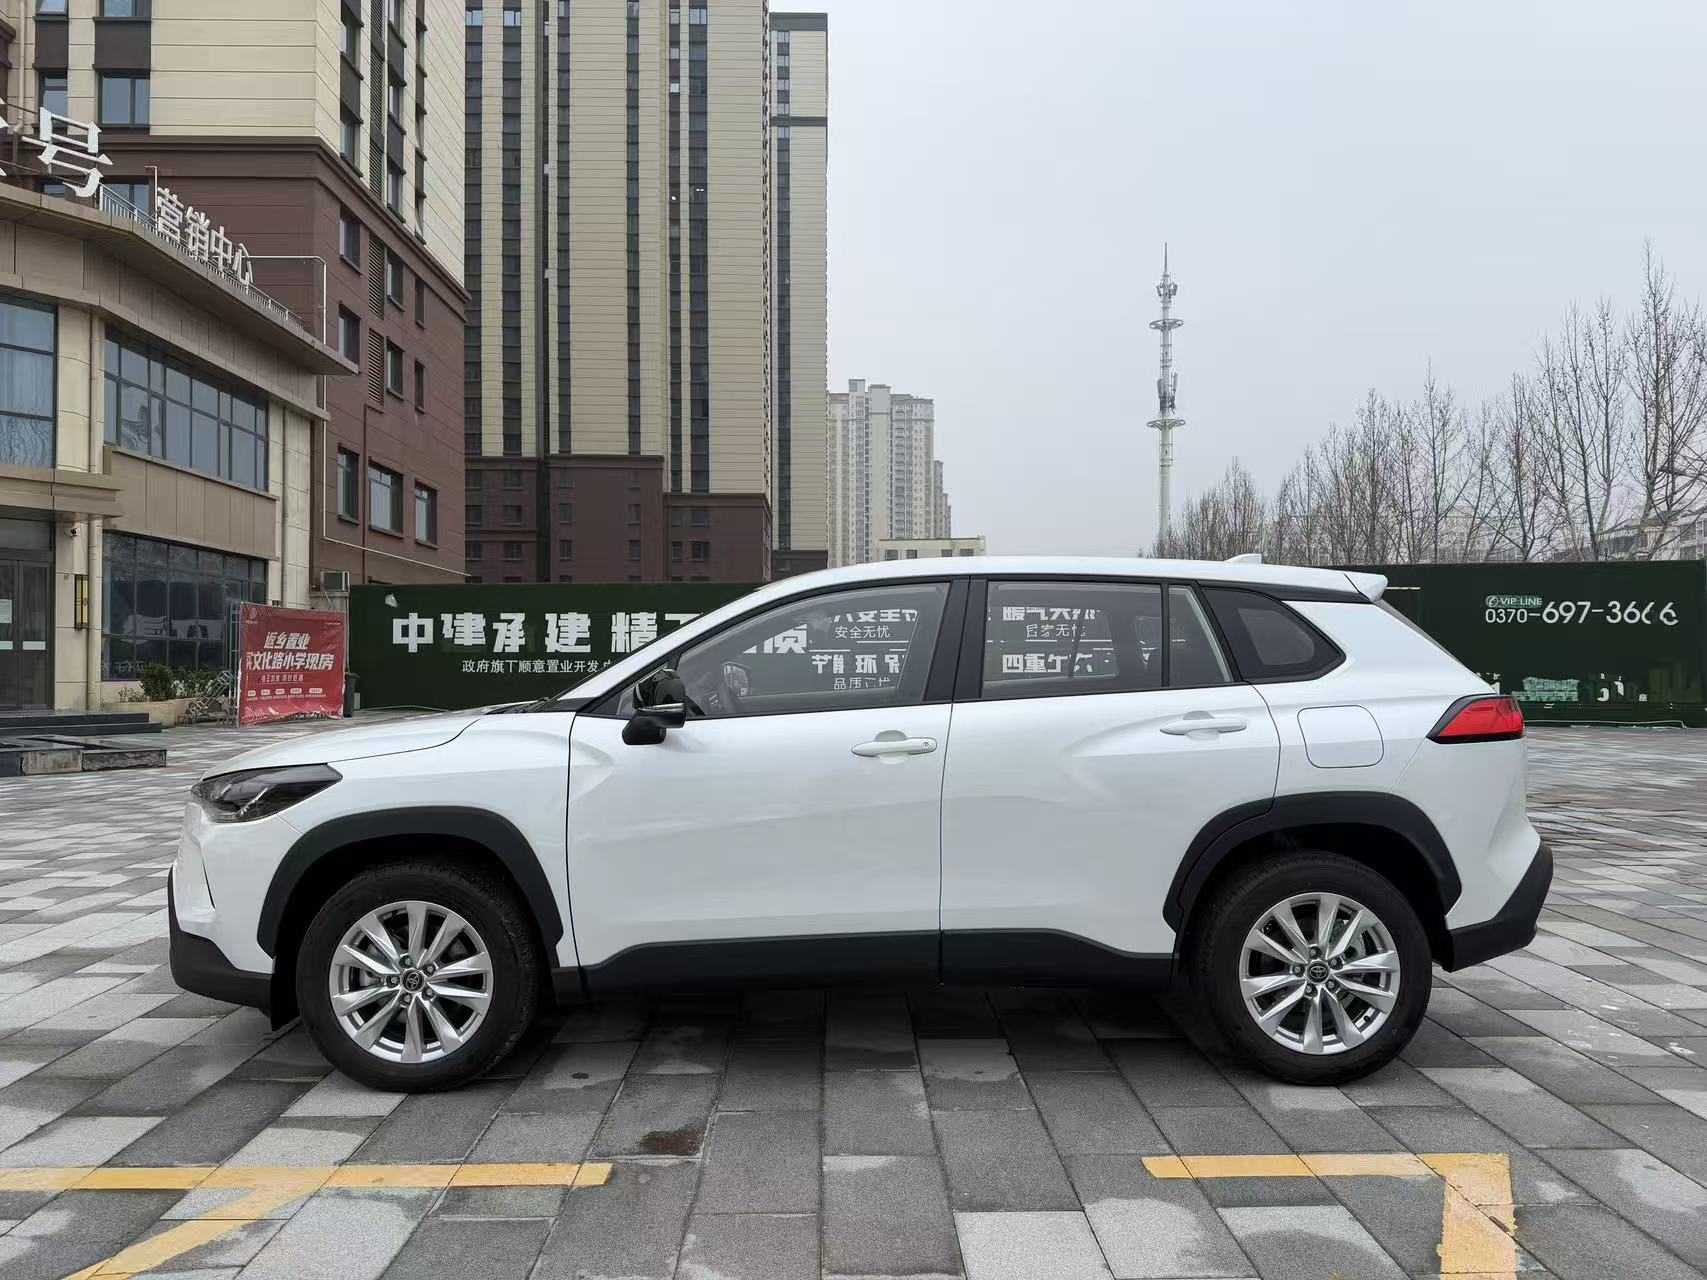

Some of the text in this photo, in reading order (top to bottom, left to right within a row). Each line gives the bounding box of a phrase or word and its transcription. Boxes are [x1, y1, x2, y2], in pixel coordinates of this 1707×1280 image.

[156, 186, 254, 287] 营销中心
[1500, 597, 1543, 606] VIP LINE
[264, 632, 311, 650] 返乡置业
[392, 612, 592, 653] 中建承建
[835, 625, 890, 639] 安全无忧
